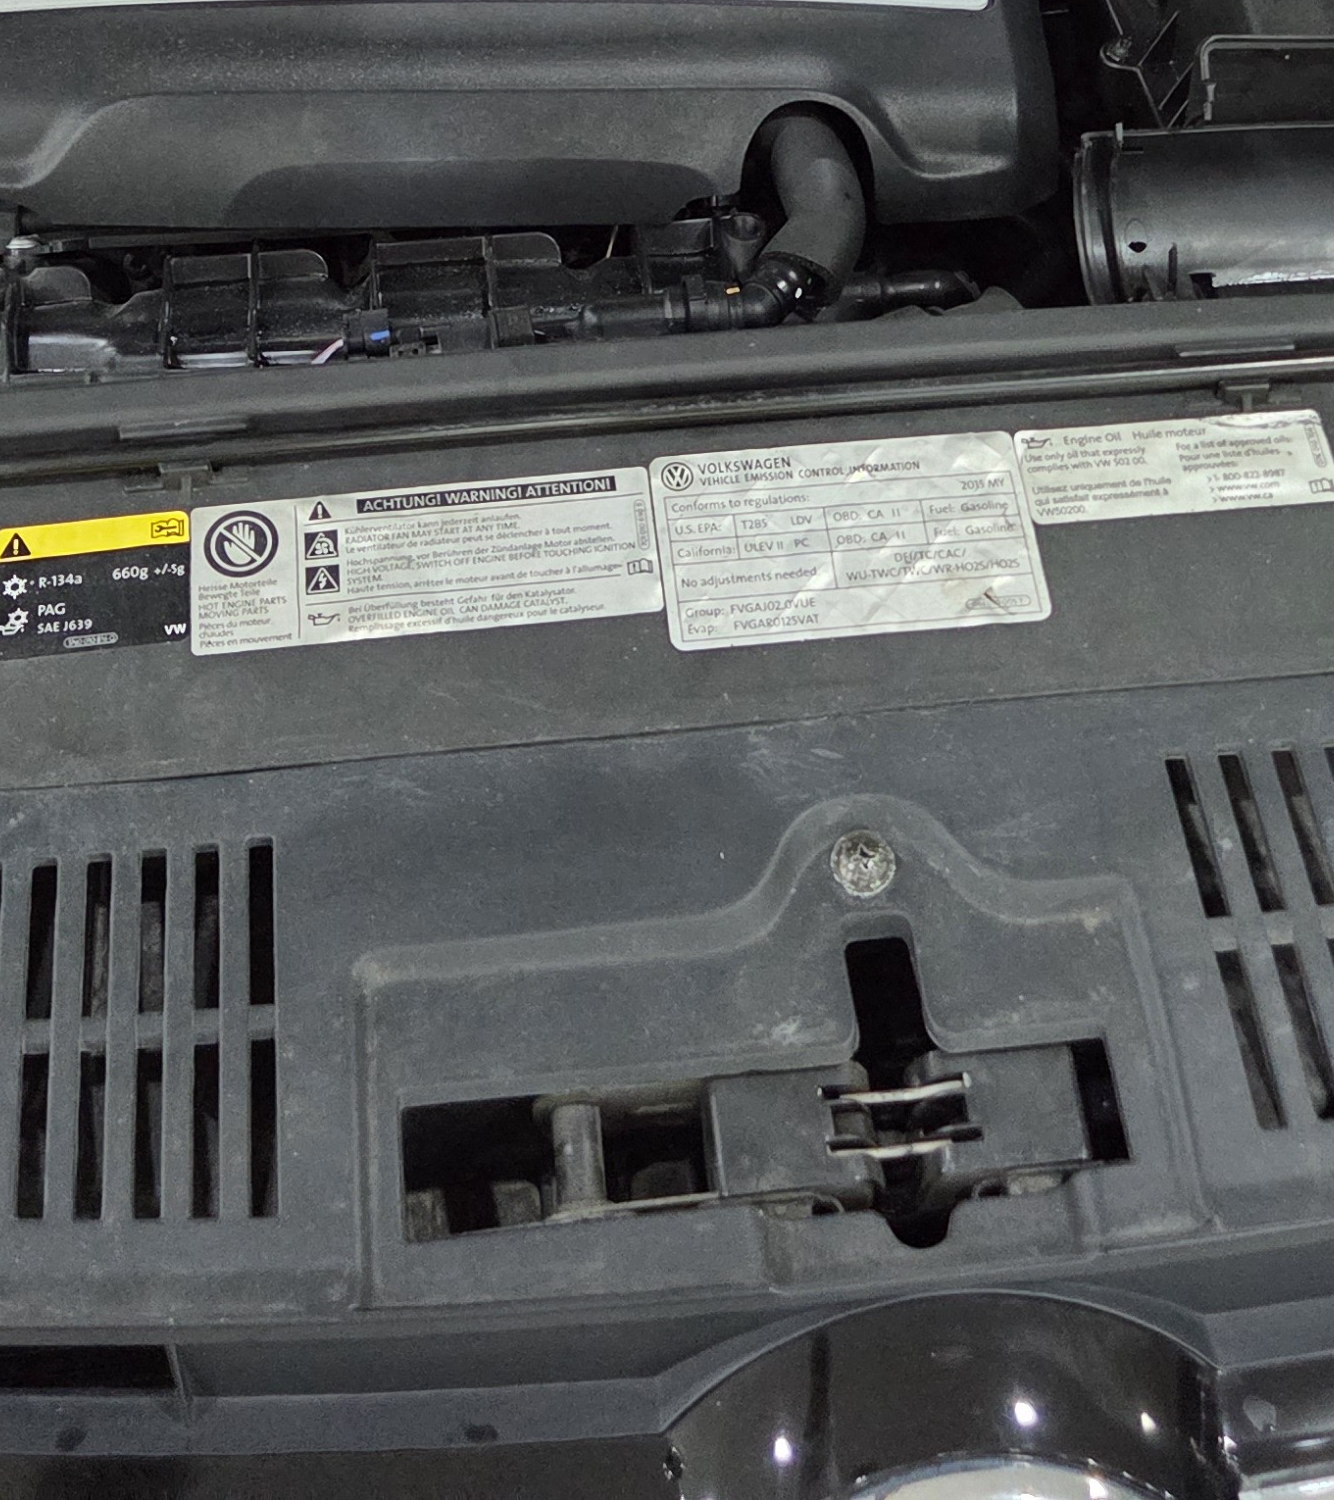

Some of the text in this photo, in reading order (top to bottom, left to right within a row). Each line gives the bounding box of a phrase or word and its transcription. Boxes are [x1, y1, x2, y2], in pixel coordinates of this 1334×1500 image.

[1063, 427, 1206, 447] Engine Oil Huile moteur
[1045, 452, 1065, 462] only
[1080, 449, 1101, 459] that
[698, 457, 791, 475] VOLKSWAGEN
[699, 460, 921, 487] VEHICLE EMISSION CONTROL INFORMATION
[1027, 463, 1069, 474] complies
[1071, 460, 1093, 470] with
[1095, 459, 1111, 468] VW
[987, 477, 1005, 488] MY
[363, 478, 611, 512] ACHTUNG! WARNING! ATTENTION!
[672, 494, 810, 513] Conforms to regulations:
[929, 501, 1008, 515] Fuel: Gasoline
[791, 515, 813, 526] LDV
[867, 508, 883, 519] CA
[417, 519, 439, 528] kann
[440, 514, 479, 529] jederzeit
[345, 532, 389, 544] RADIATOR
[391, 530, 411, 540] FAN
[411, 528, 431, 539] MAY
[433, 526, 460, 537] START
[461, 525, 473, 534] AT
[475, 523, 493, 533] ANY
[407, 538, 418, 548] de
[419, 535, 461, 547] radiateur
[462, 532, 483, 545] peut
[485, 533, 494, 541] se
[551, 524, 571, 535] tout
[675, 525, 695, 536] U.S.
[871, 531, 887, 542] CA
[417, 551, 431, 560] vor
[475, 545, 489, 555] der
[545, 537, 571, 548] Motor
[677, 545, 736, 558] California:
[744, 541, 773, 553] ULEV
[795, 537, 810, 548] PC
[347, 565, 371, 576] HIGH
[417, 557, 451, 569] SWITCH
[453, 555, 471, 566] OFF
[472, 552, 507, 564] ENGINE
[509, 549, 542, 560] BEFORE
[543, 544, 593, 557] TOUCHING
[593, 540, 636, 552] IGNITION
[38, 563, 185, 589] R-134a 660g +/-5g
[347, 583, 375, 594] Haute
[455, 574, 488, 584] moteur
[490, 570, 515, 581] avant
[517, 569, 527, 579] de
[529, 566, 563, 577] toucher
[681, 565, 817, 588] No adjustments needed
[198, 577, 277, 593] Heisse Motorteile
[240, 587, 261, 597] Teile
[37, 602, 66, 616] PAG
[198, 596, 287, 611] HOT ENGINE PARTS
[348, 603, 362, 614] Bei
[420, 595, 455, 607] besteht
[457, 593, 487, 604] Gefahr
[505, 590, 523, 600] den
[199, 606, 269, 620] MOVING PARTS
[349, 610, 401, 624] OVERFILLED
[403, 607, 437, 619] ENGINE
[440, 606, 455, 616] OIL
[459, 604, 479, 614] CAN
[481, 600, 521, 612] DAMAGE
[407, 615, 442, 627] excessif
[444, 612, 475, 624] d'huile
[477, 610, 523, 622] dangereux
[527, 607, 547, 619] pour
[685, 607, 725, 618] Group:
[37, 618, 93, 634] SAE J639
[164, 623, 187, 636] VW
[227, 619, 237, 628] du
[239, 617, 271, 627] moteur
[227, 638, 238, 646] en
[239, 631, 292, 644] mouvement
